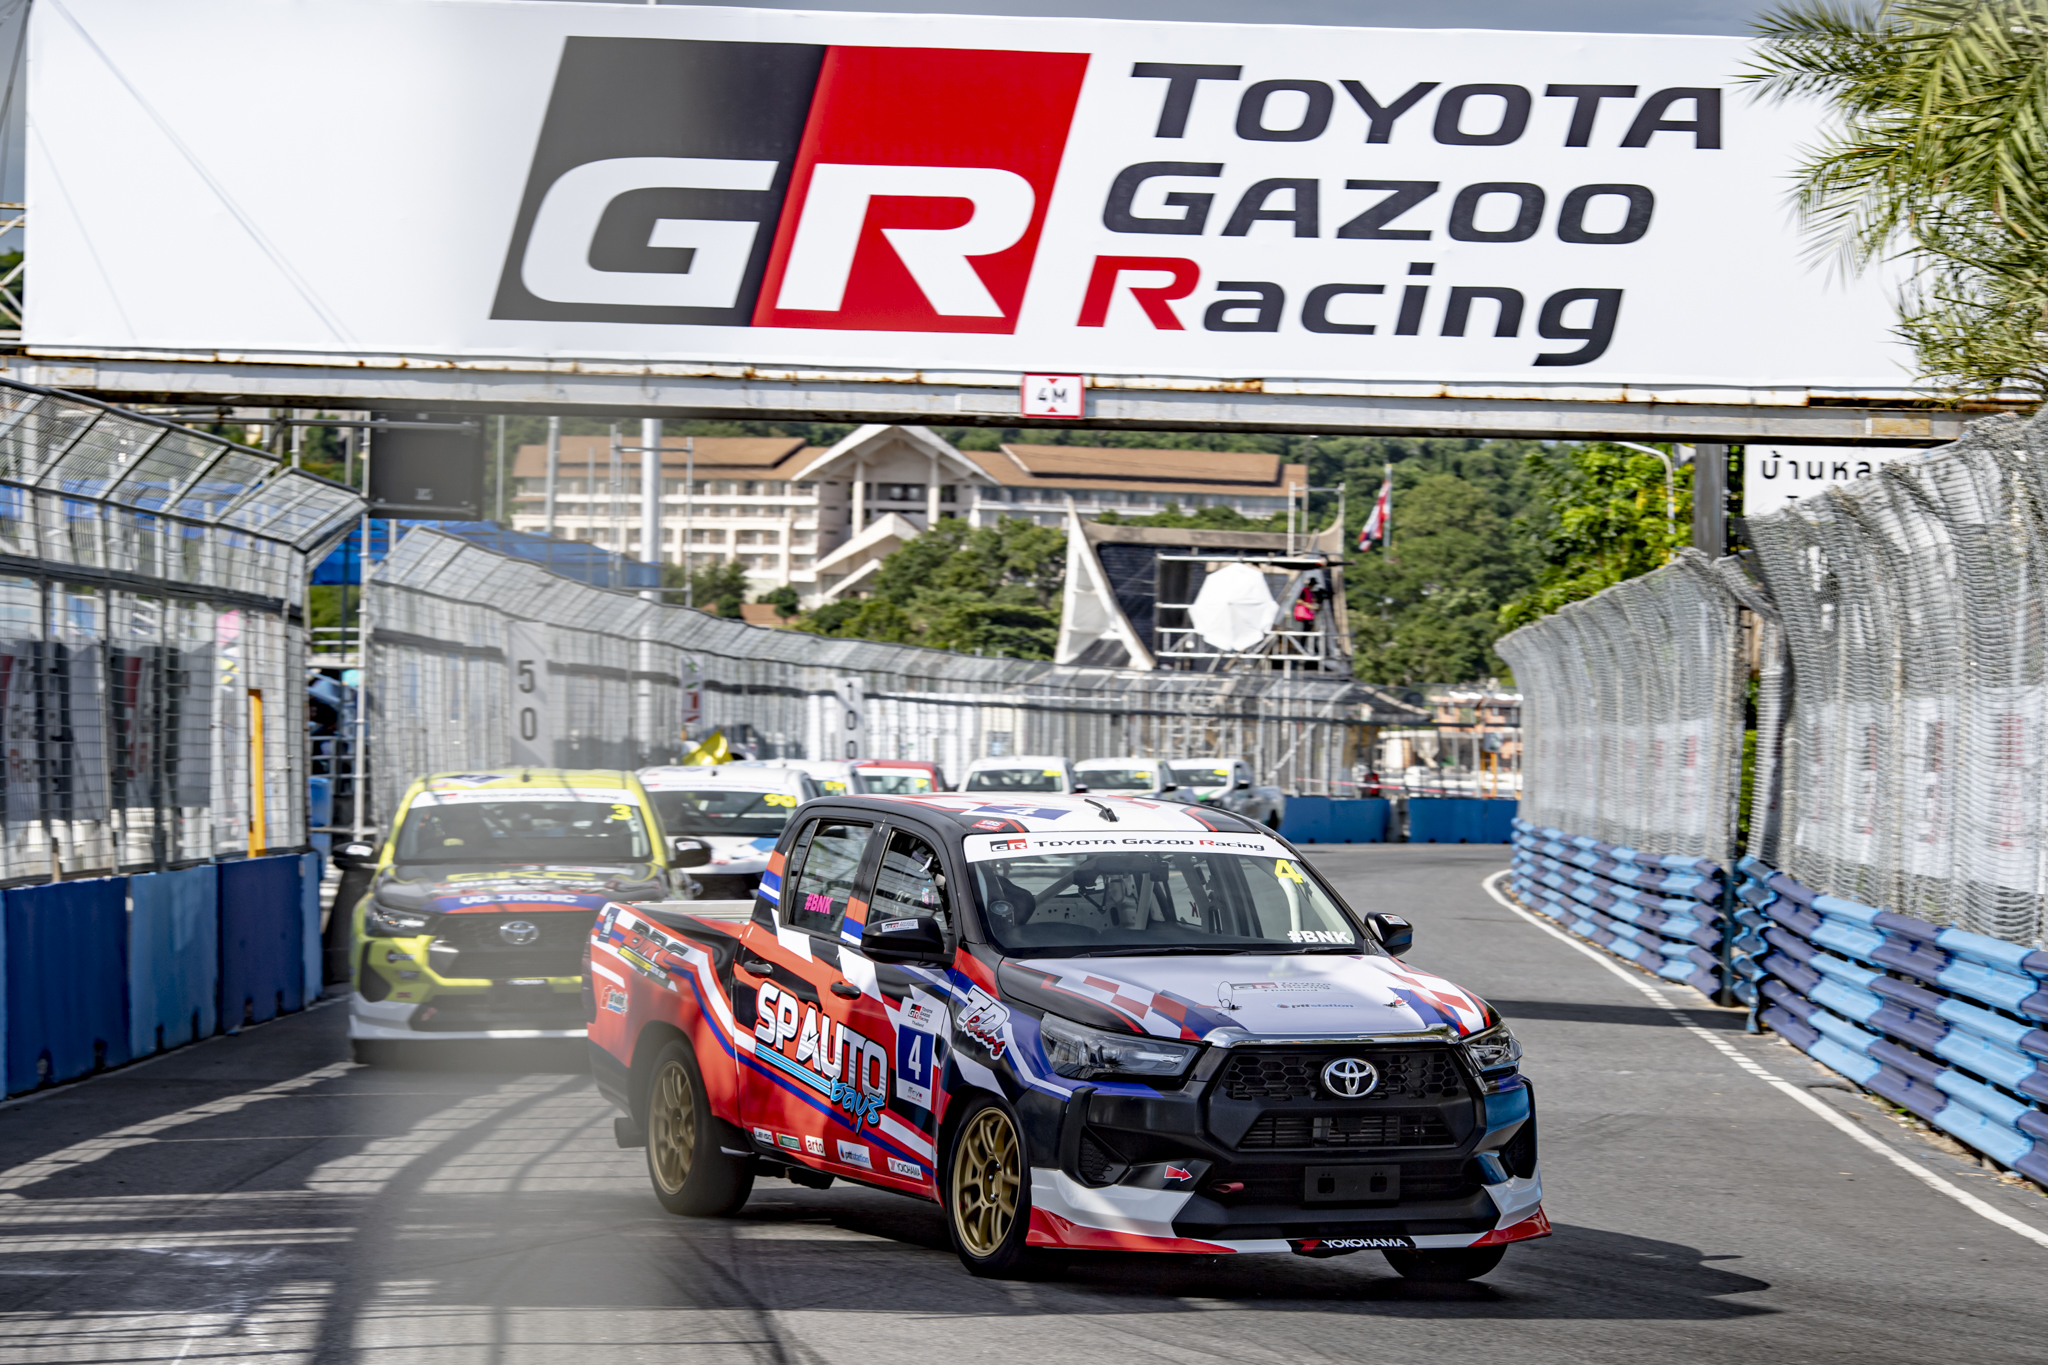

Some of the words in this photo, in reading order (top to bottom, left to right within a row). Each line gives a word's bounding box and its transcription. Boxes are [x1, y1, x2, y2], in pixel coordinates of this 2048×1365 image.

[1131, 62, 1722, 149] TOYOTA
[1102, 161, 1655, 245] GAZOO
[520, 156, 1036, 318] GR
[1076, 255, 1625, 367] Racing
[1761, 451, 1886, 480] บ้านหล
[611, 804, 632, 820] 3
[991, 840, 1027, 852] GR
[1034, 839, 1116, 848] TOYOTA
[1199, 839, 1265, 851] Racing
[1274, 859, 1304, 884] 4
[804, 893, 834, 915] #BNK
[1287, 930, 1355, 944] #BNK
[908, 1034, 922, 1080] 4
[807, 1140, 824, 1154] arto
[1321, 1239, 1409, 1249] YOKOHAMA
